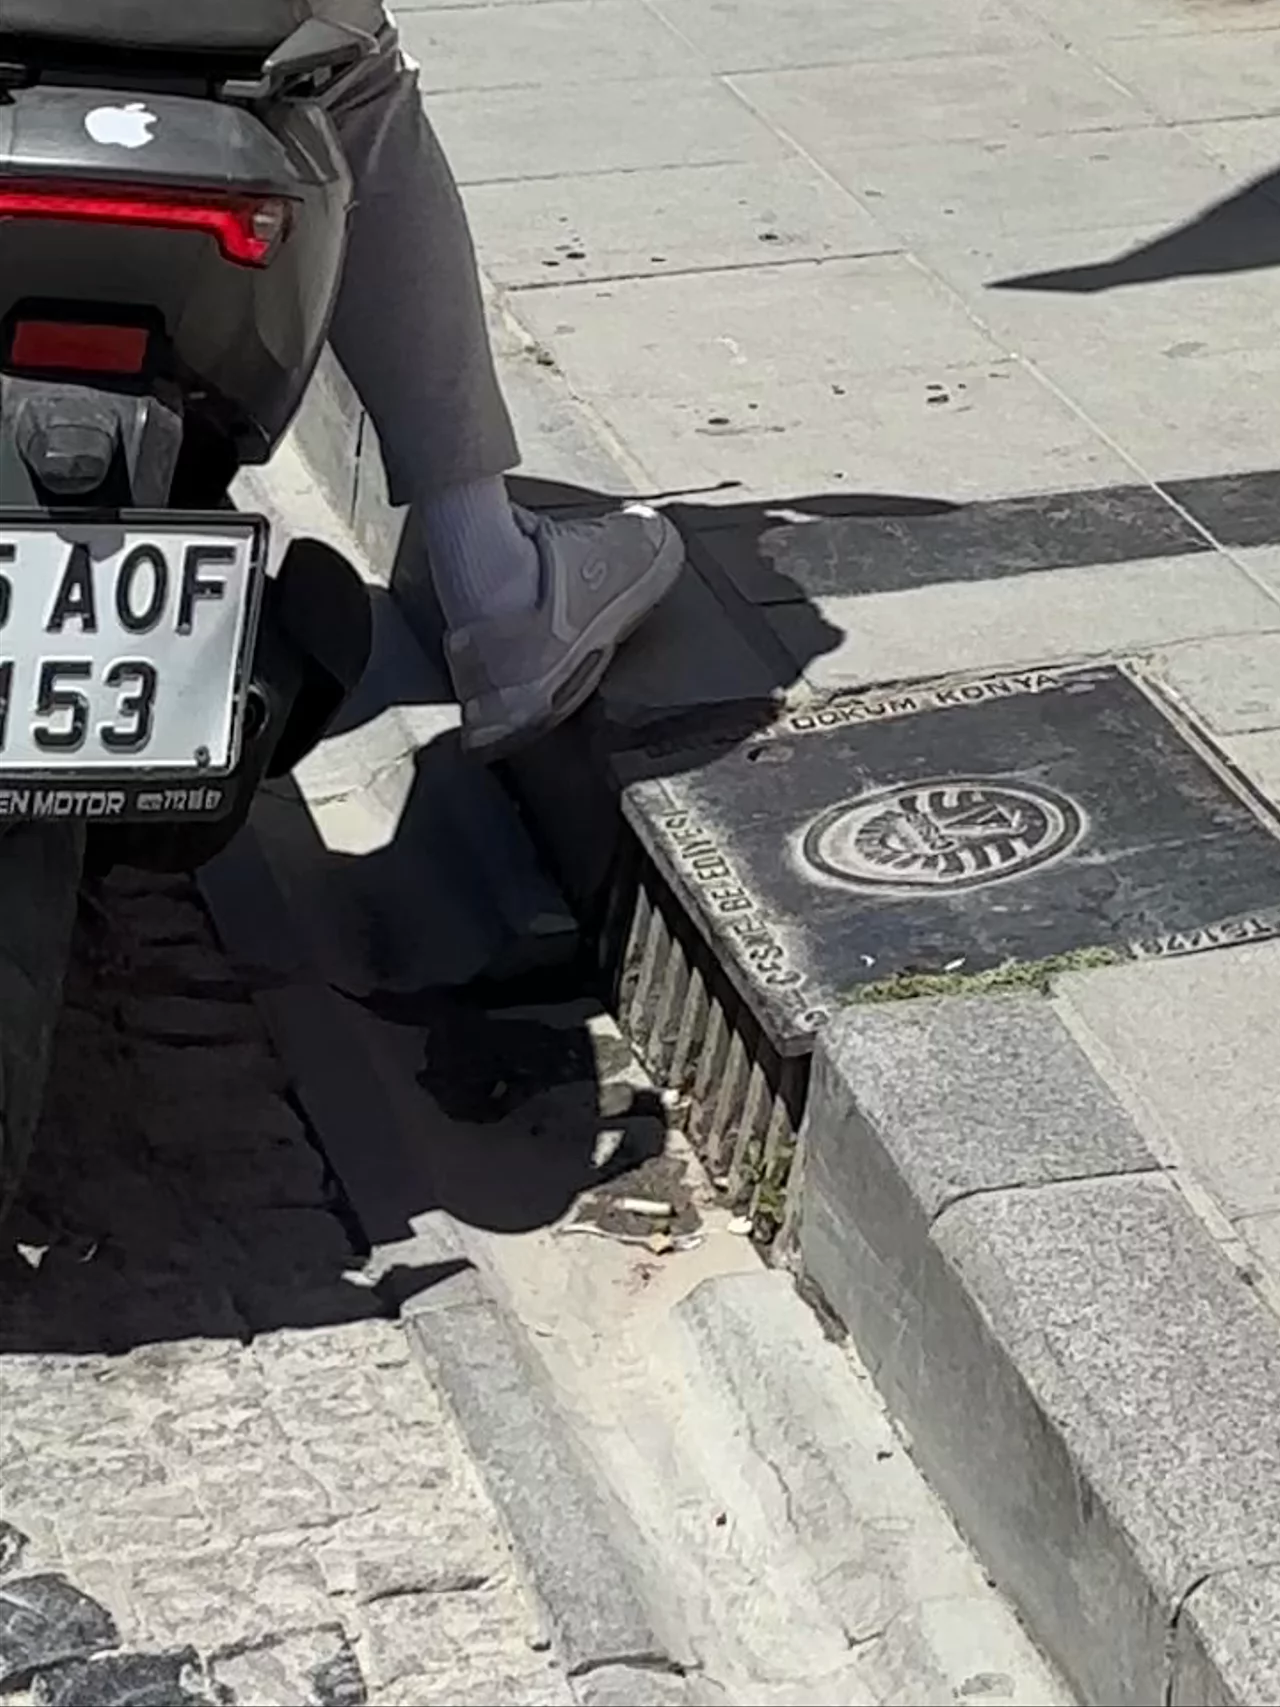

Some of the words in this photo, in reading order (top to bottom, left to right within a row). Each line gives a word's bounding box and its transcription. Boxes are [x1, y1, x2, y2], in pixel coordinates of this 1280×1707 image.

[45, 541, 236, 636] AOF
[936, 673, 1060, 706] KONYA
[33, 789, 126, 816] MOTOR
